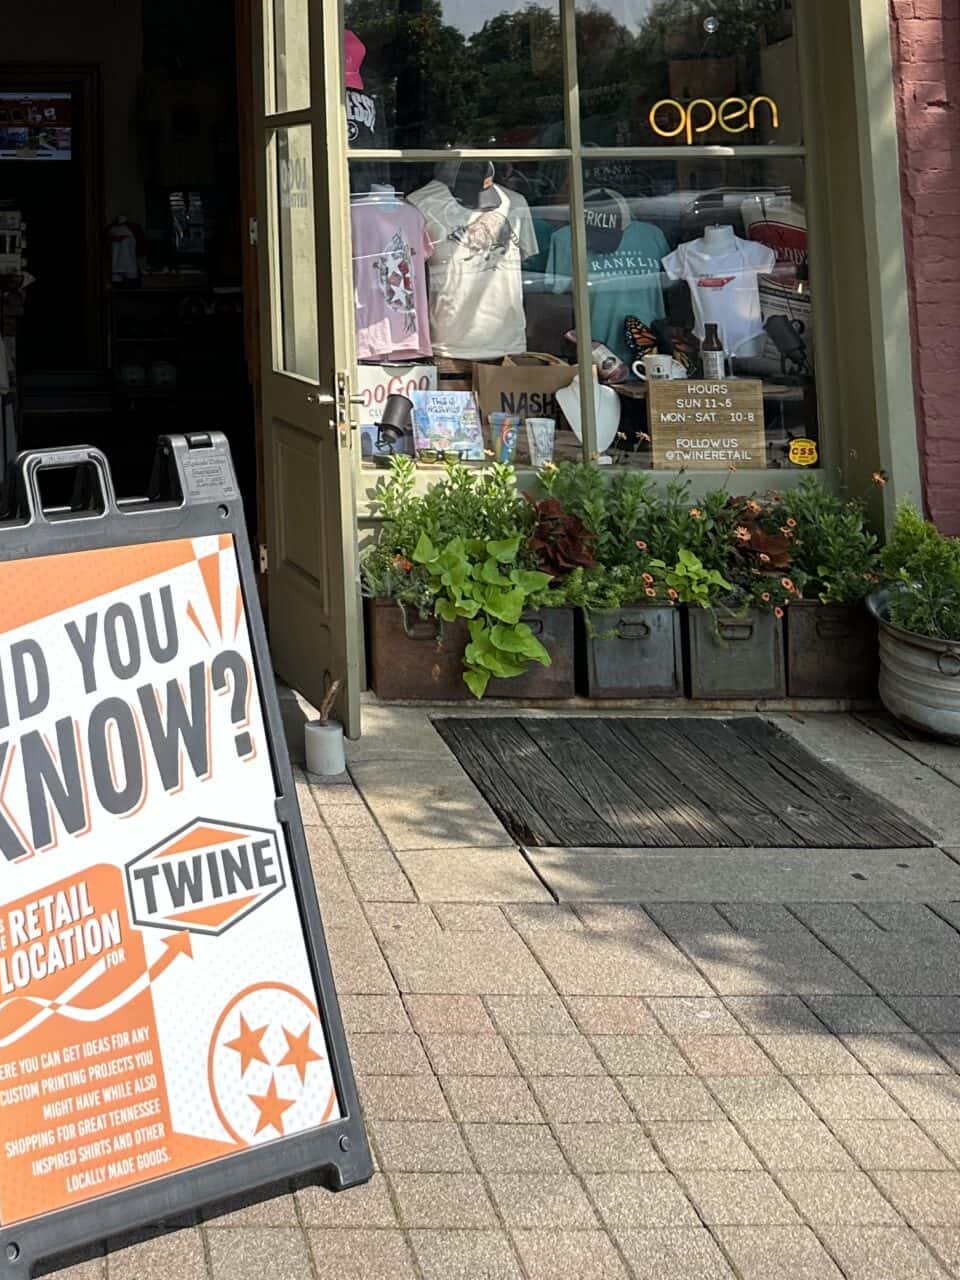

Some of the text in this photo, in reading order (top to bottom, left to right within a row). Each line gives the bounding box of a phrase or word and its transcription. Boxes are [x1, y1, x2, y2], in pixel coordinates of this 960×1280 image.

[648, 95, 780, 145] open
[591, 256, 661, 271] RANKLI
[676, 399, 701, 408] SUN
[688, 384, 728, 394] HOURS
[695, 412, 717, 422] SAT
[665, 451, 752, 461] @TWINERETAIL
[676, 439, 738, 448] FOLLOW US
[791, 447, 815, 456] CSS
[64, 584, 179, 695] YOU
[134, 838, 278, 915] TWINE
[8, 881, 95, 948] RETAIL
[106, 948, 126, 968] FOR
[19, 1056, 39, 1074] YOU
[40, 1050, 61, 1069] CAN
[63, 1044, 81, 1063] GET
[83, 1037, 111, 1058] IDEAS
[111, 1031, 129, 1049] FOR
[131, 1026, 150, 1044] ANY
[0, 1050, 154, 1107] CUSTOM PRINTING PROJECTS YOU
[43, 1074, 157, 1120] MIGHT HAVE WHILE ALSO
[5, 1098, 161, 1158] SHOPPING FOR GREAT TENNESSEE
[31, 1123, 166, 1176] INSPIRED SHIRTS AND OTHER
[66, 1148, 172, 1193] LOCALLY MADE GOODS.
